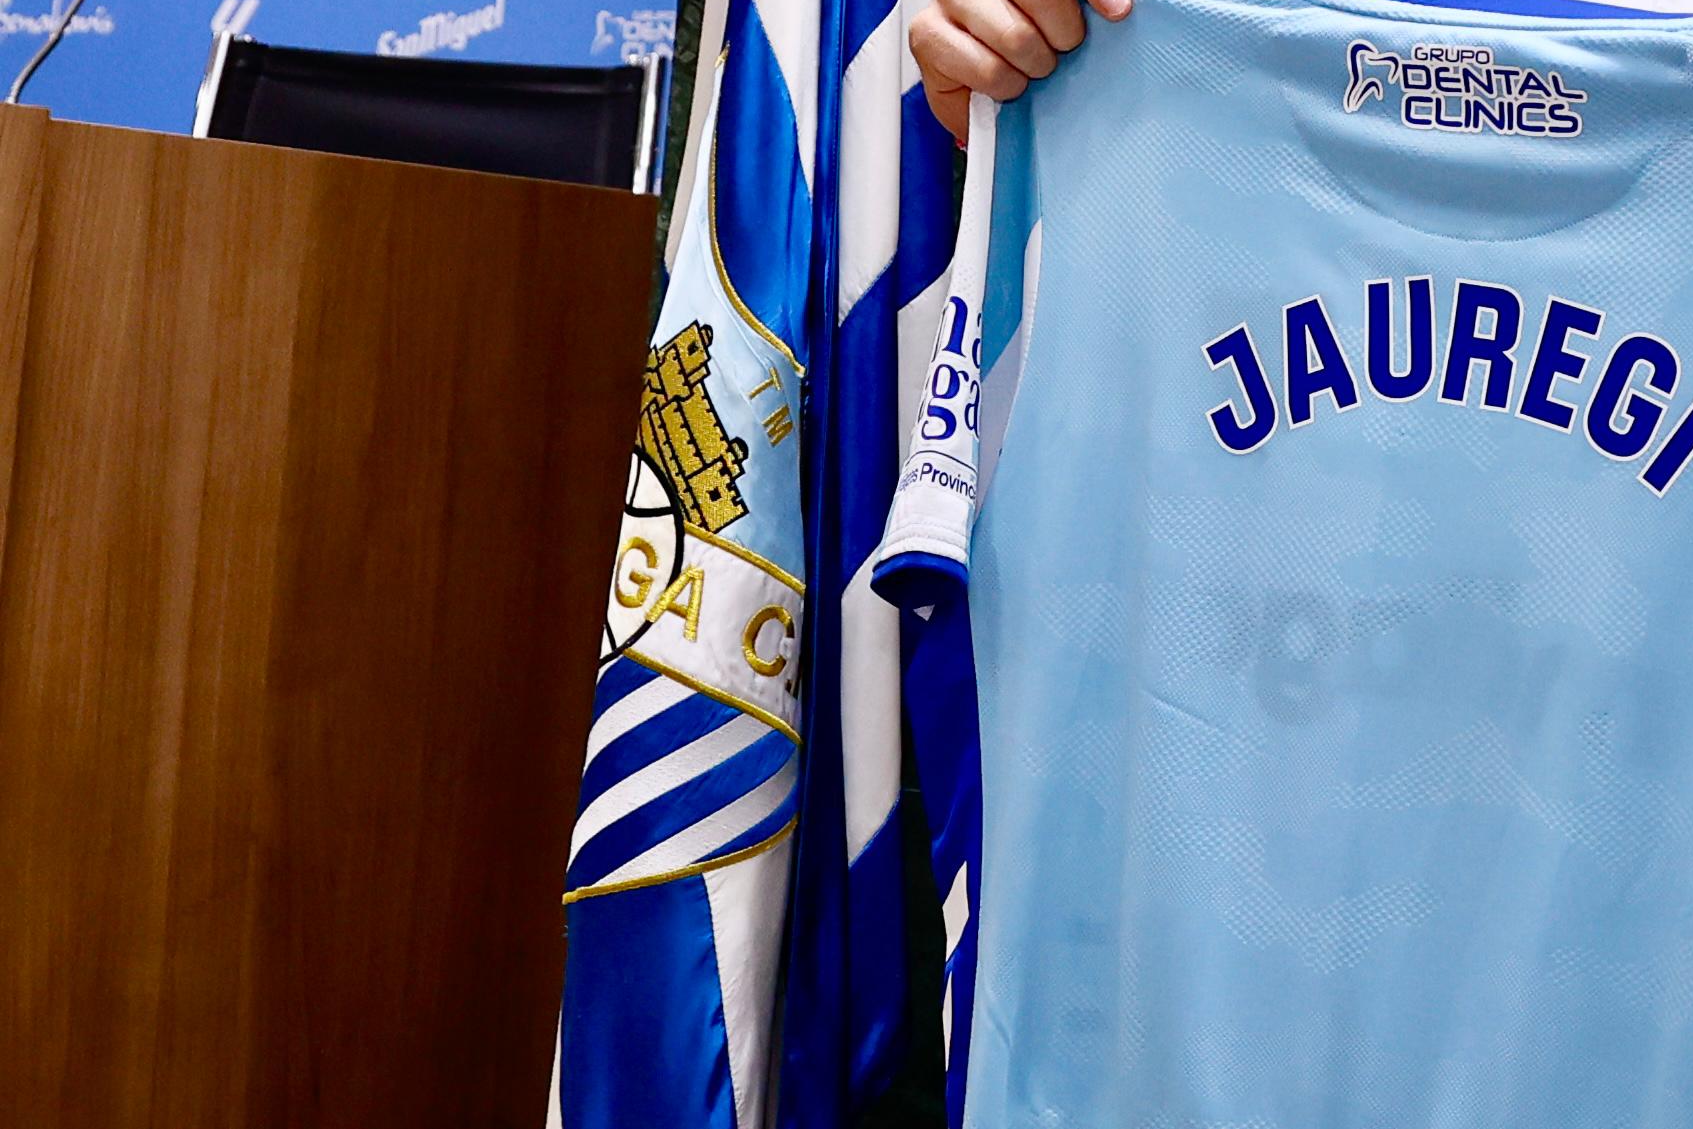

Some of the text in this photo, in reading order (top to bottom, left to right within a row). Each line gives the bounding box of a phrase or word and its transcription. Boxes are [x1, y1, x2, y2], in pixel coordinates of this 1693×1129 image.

[1412, 45, 1492, 66] GRUPO
[1401, 62, 1585, 100] DENTAL
[1404, 95, 1580, 134] CLINICS
